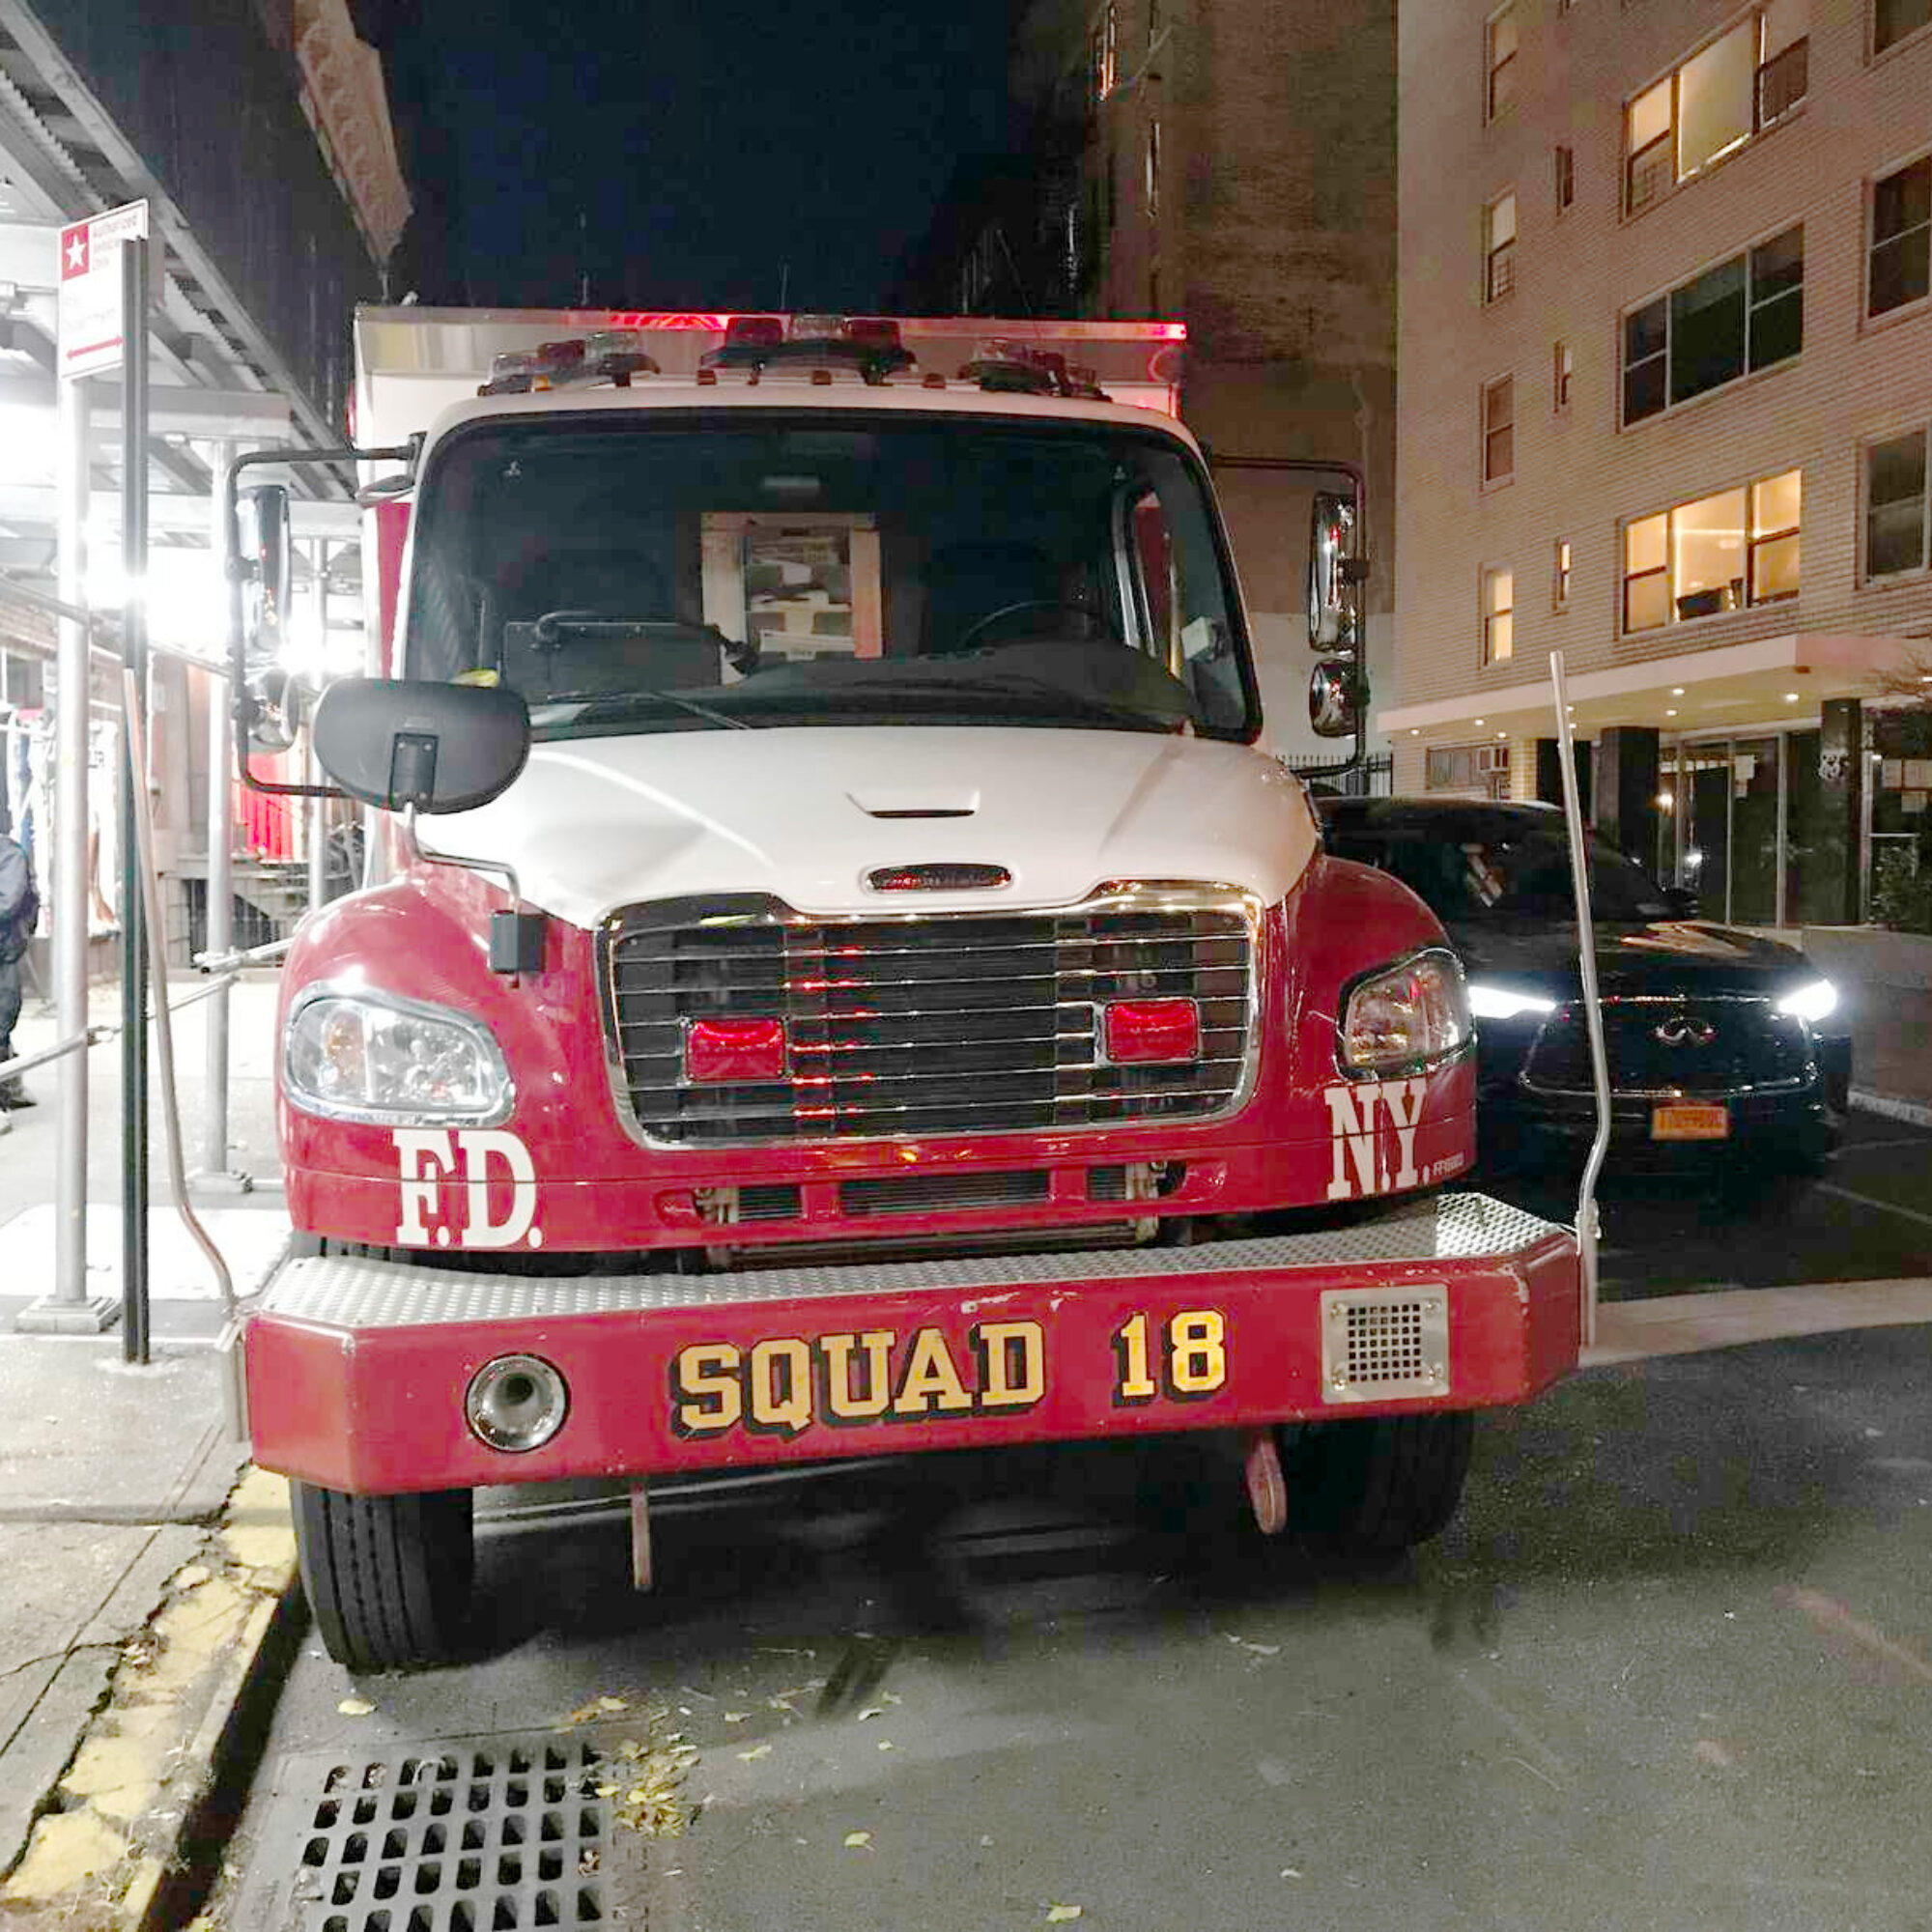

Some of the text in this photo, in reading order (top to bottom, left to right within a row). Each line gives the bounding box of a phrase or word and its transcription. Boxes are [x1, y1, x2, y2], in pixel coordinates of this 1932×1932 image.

[392, 1128, 543, 1249] F.D.
[1323, 1077, 1430, 1201] N.Y.
[676, 1310, 1227, 1436] SQUAD 18
